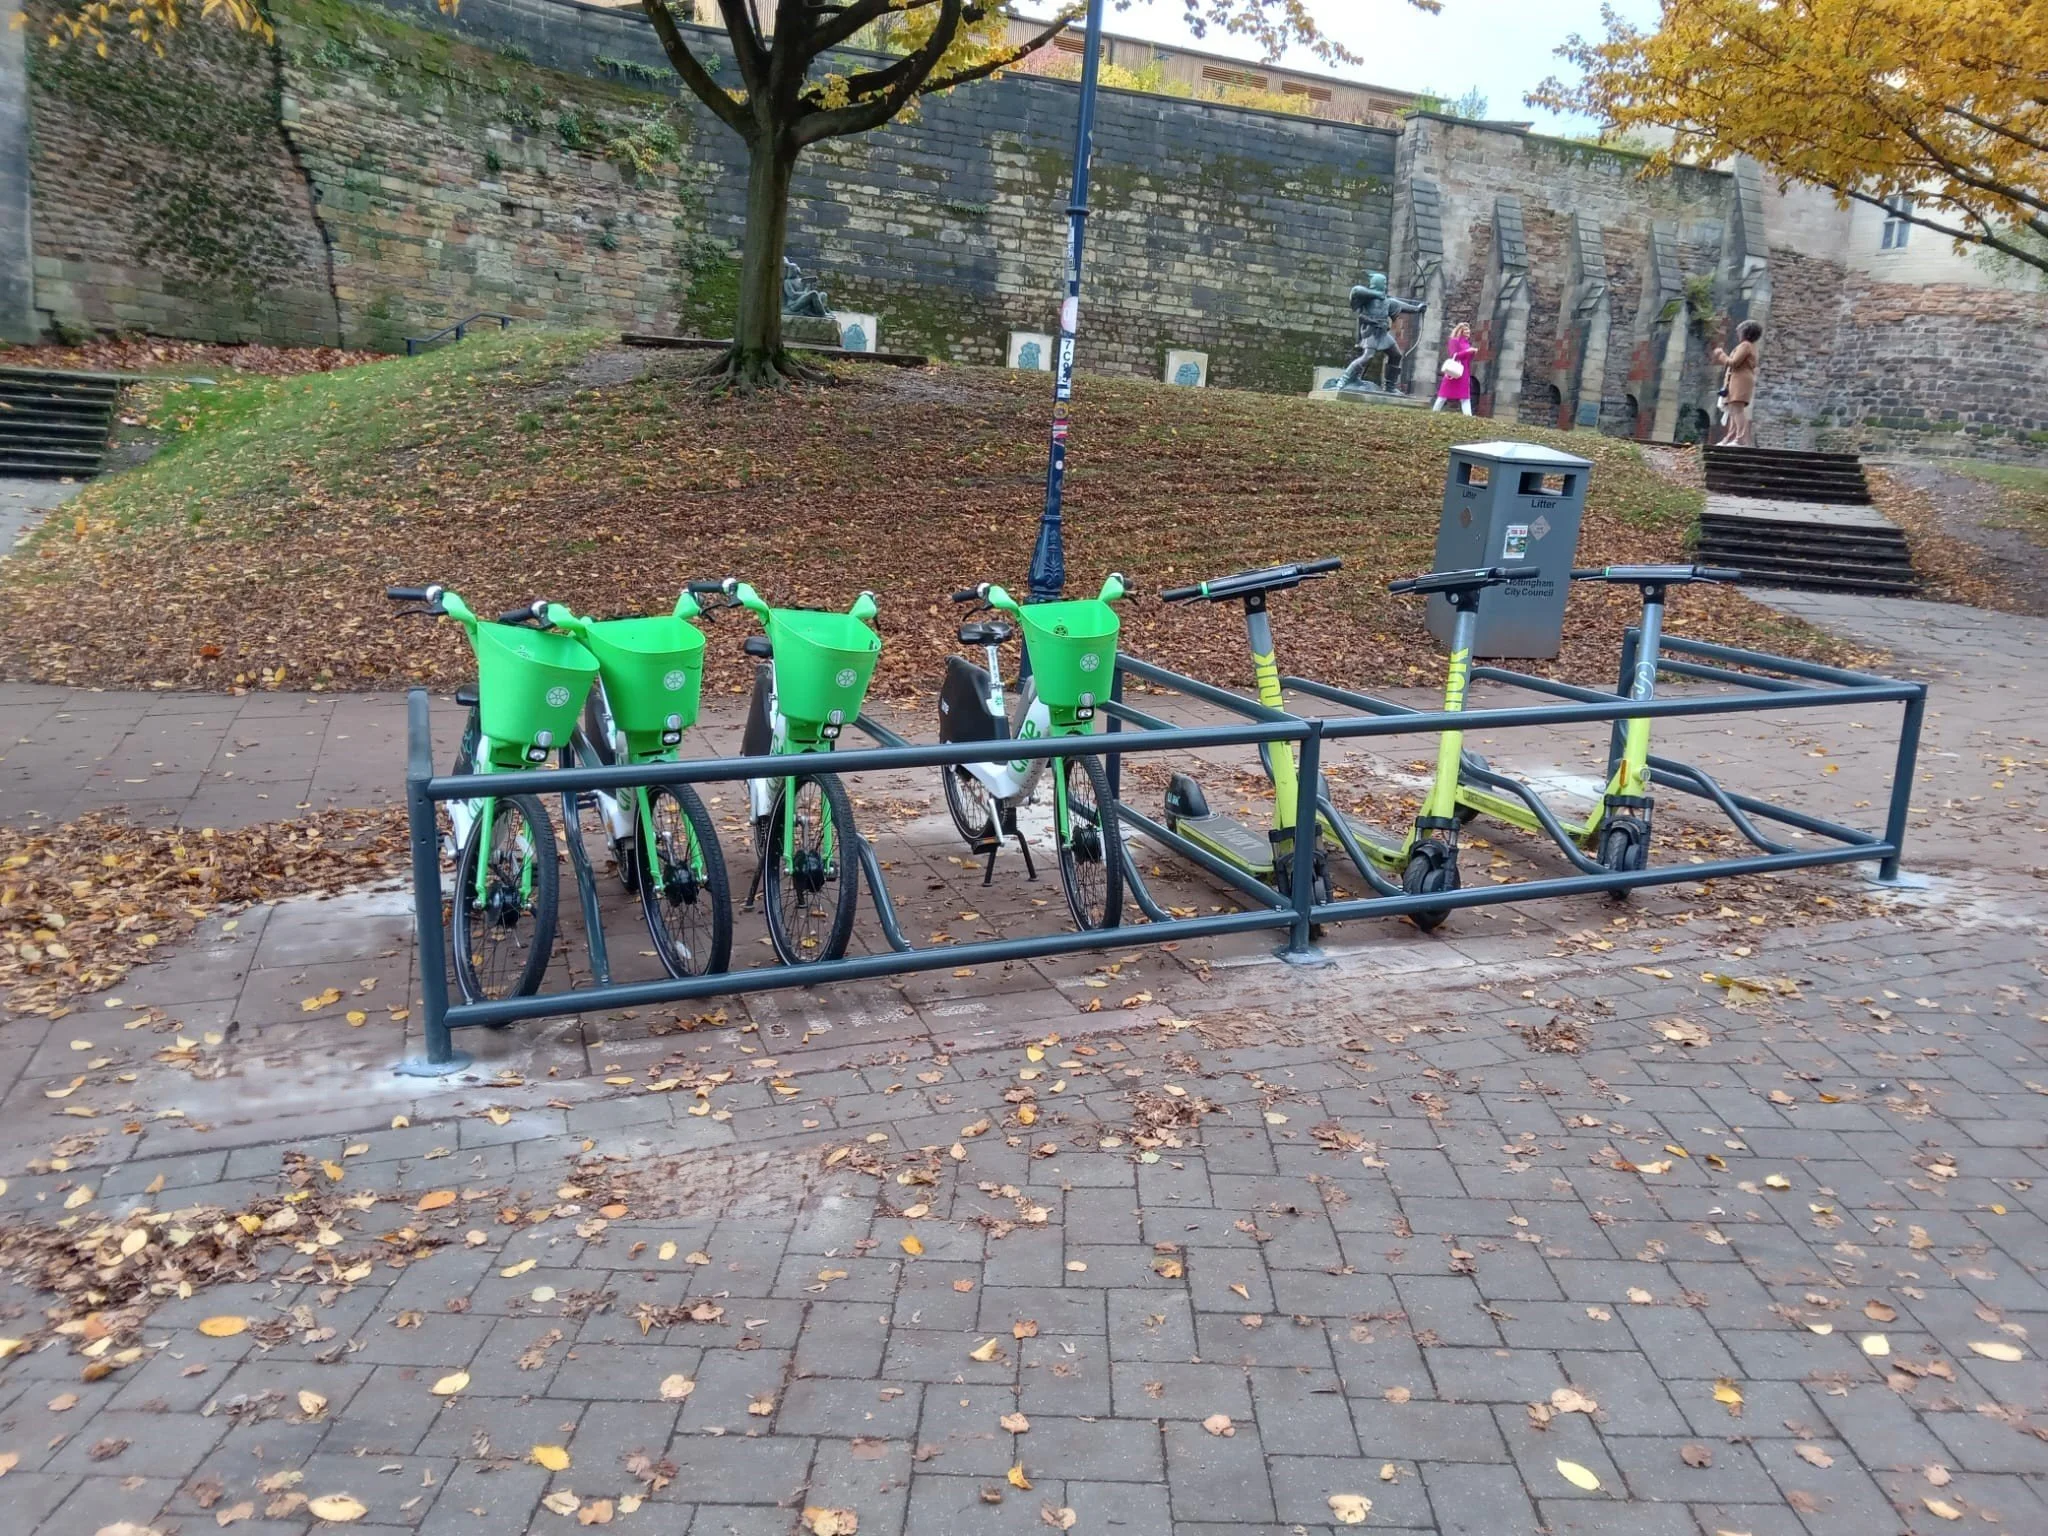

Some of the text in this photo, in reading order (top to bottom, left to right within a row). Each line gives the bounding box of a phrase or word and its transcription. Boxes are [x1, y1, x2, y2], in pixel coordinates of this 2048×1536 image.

[1531, 499, 1556, 509] Litter
[1504, 588, 1554, 597] City Council
